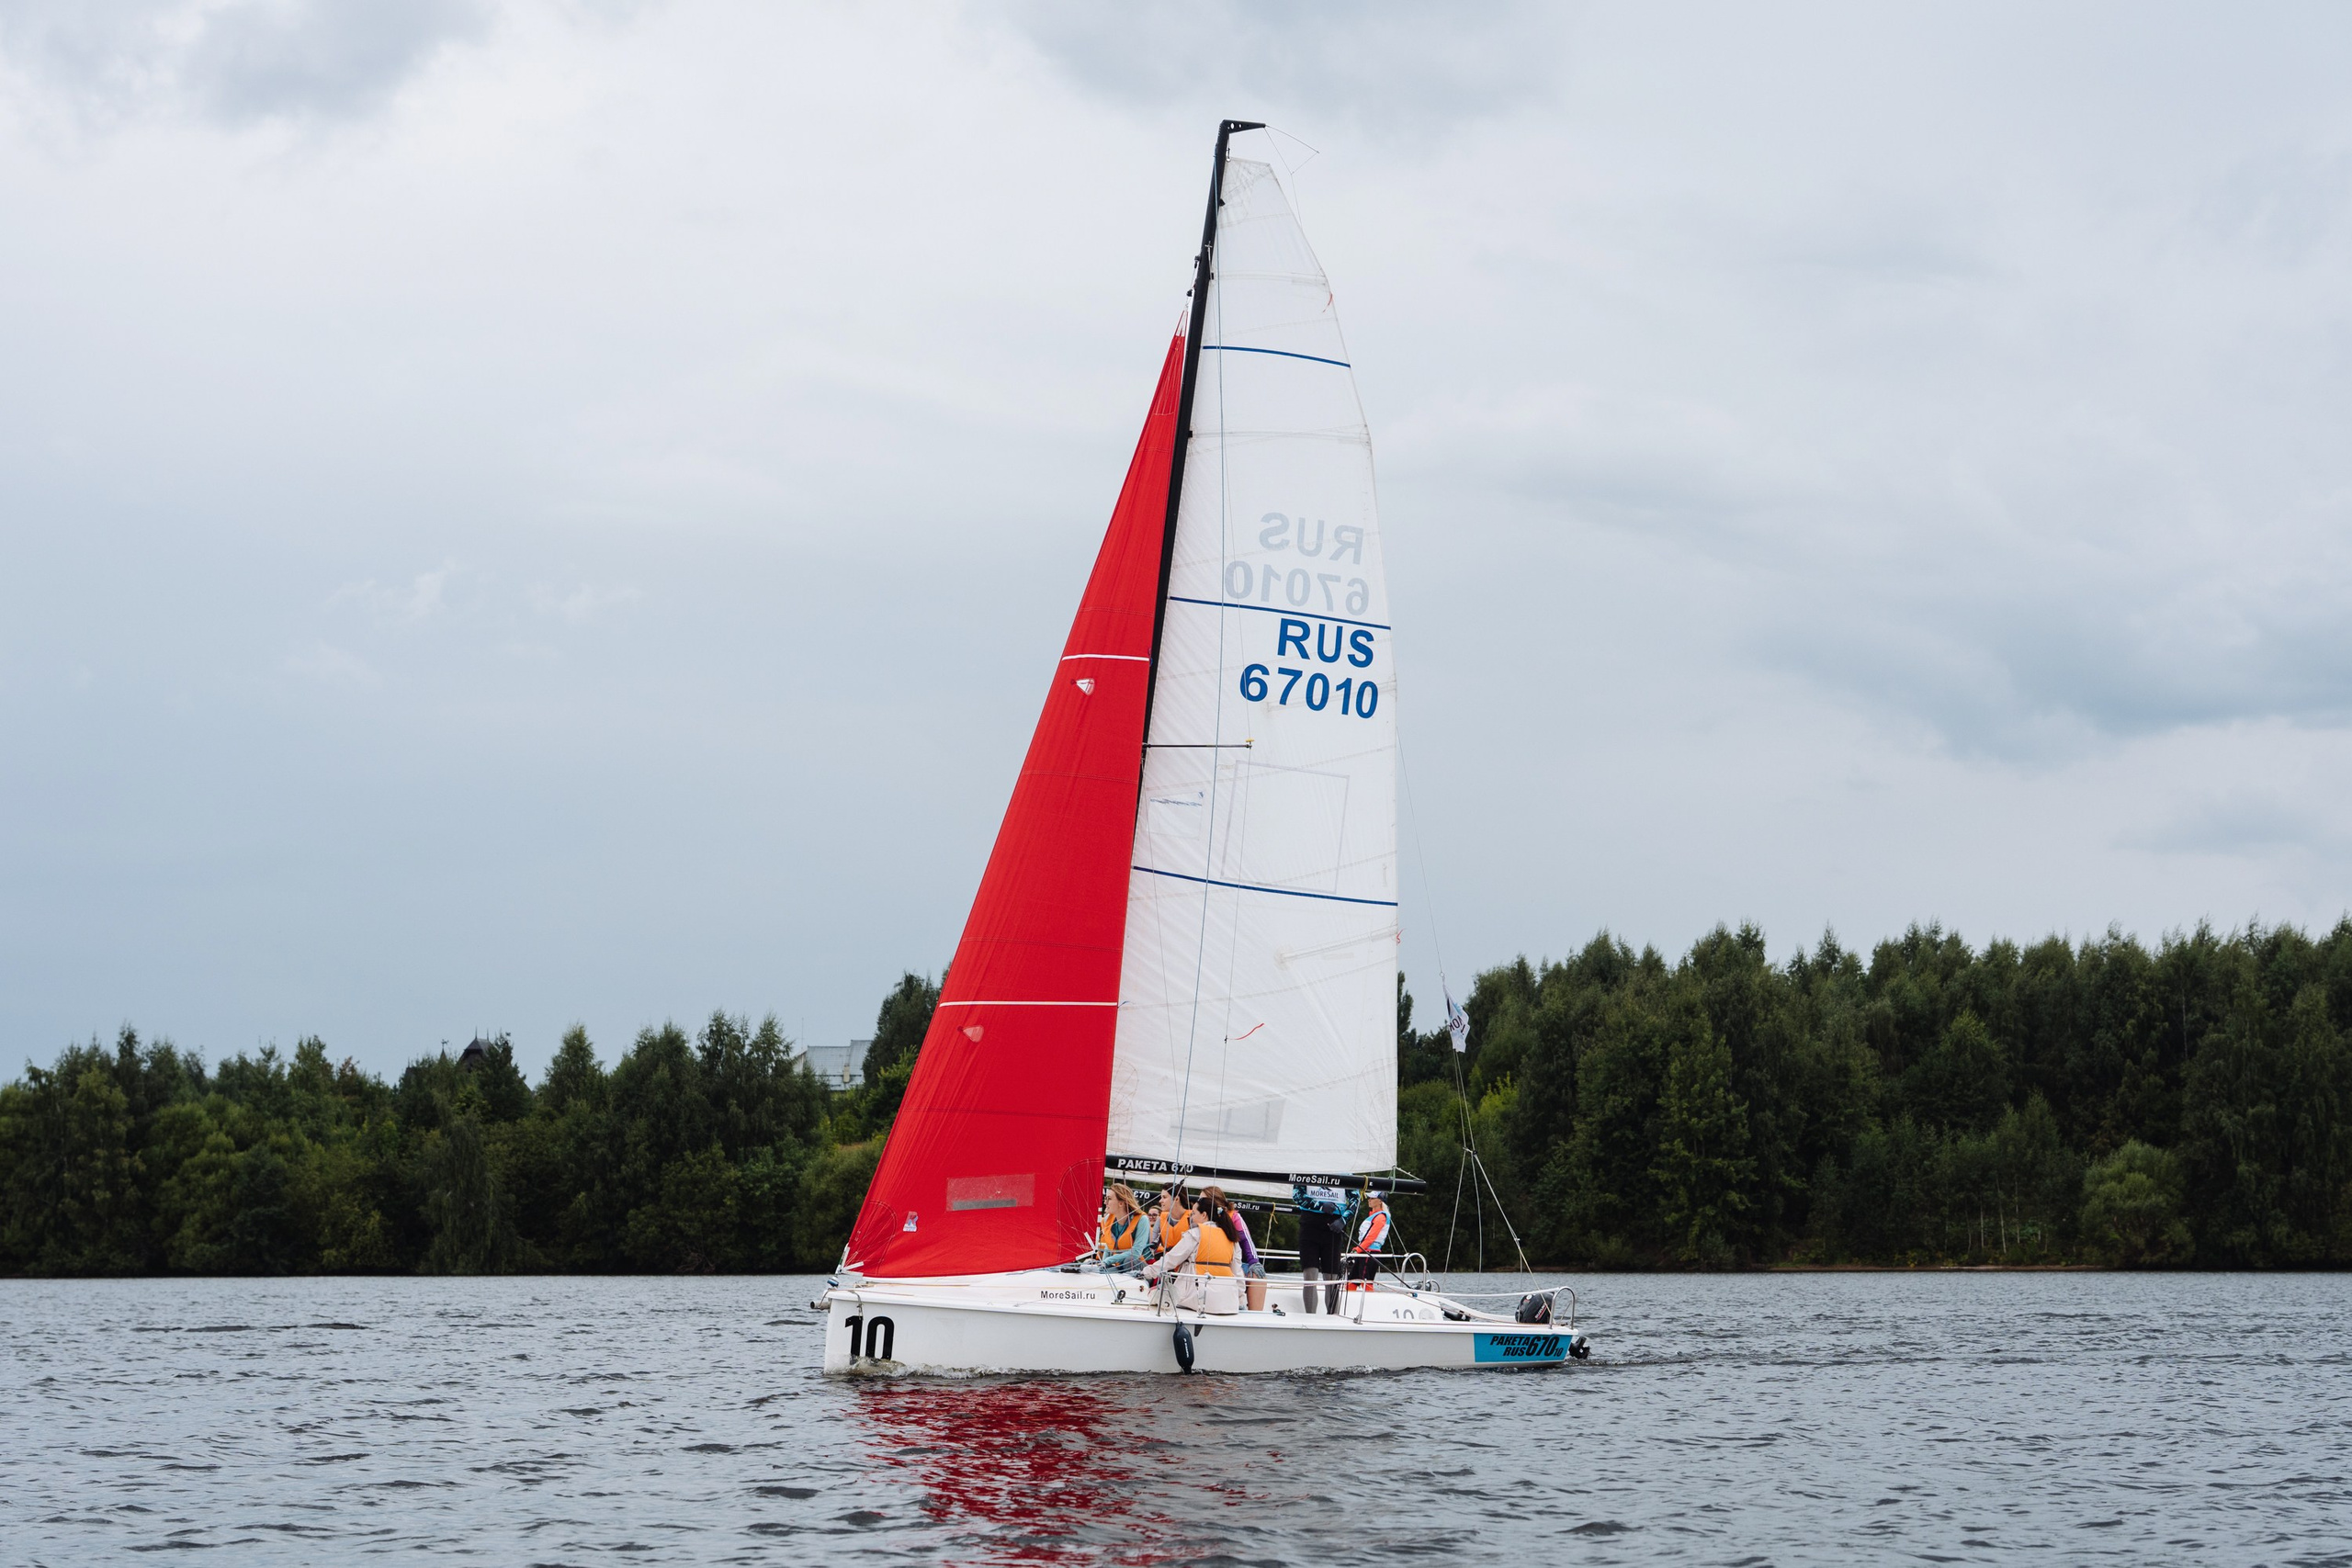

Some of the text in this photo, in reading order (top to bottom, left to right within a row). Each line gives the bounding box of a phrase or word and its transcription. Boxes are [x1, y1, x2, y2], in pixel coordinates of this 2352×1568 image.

[1277, 617, 1374, 668] RUS
[1240, 663, 1378, 718] 67010
[1170, 1162, 1194, 1173] 670
[1288, 1172, 1340, 1185] MoreSail.ru
[1310, 1190, 1340, 1199] MORESAIL
[1233, 1201, 1260, 1211] eSail.ru
[1040, 1290, 1096, 1300] MoreSail.ru
[844, 1314, 895, 1365] 10
[1503, 1347, 1564, 1357] RUS 10
[1525, 1336, 1560, 1357] 670
